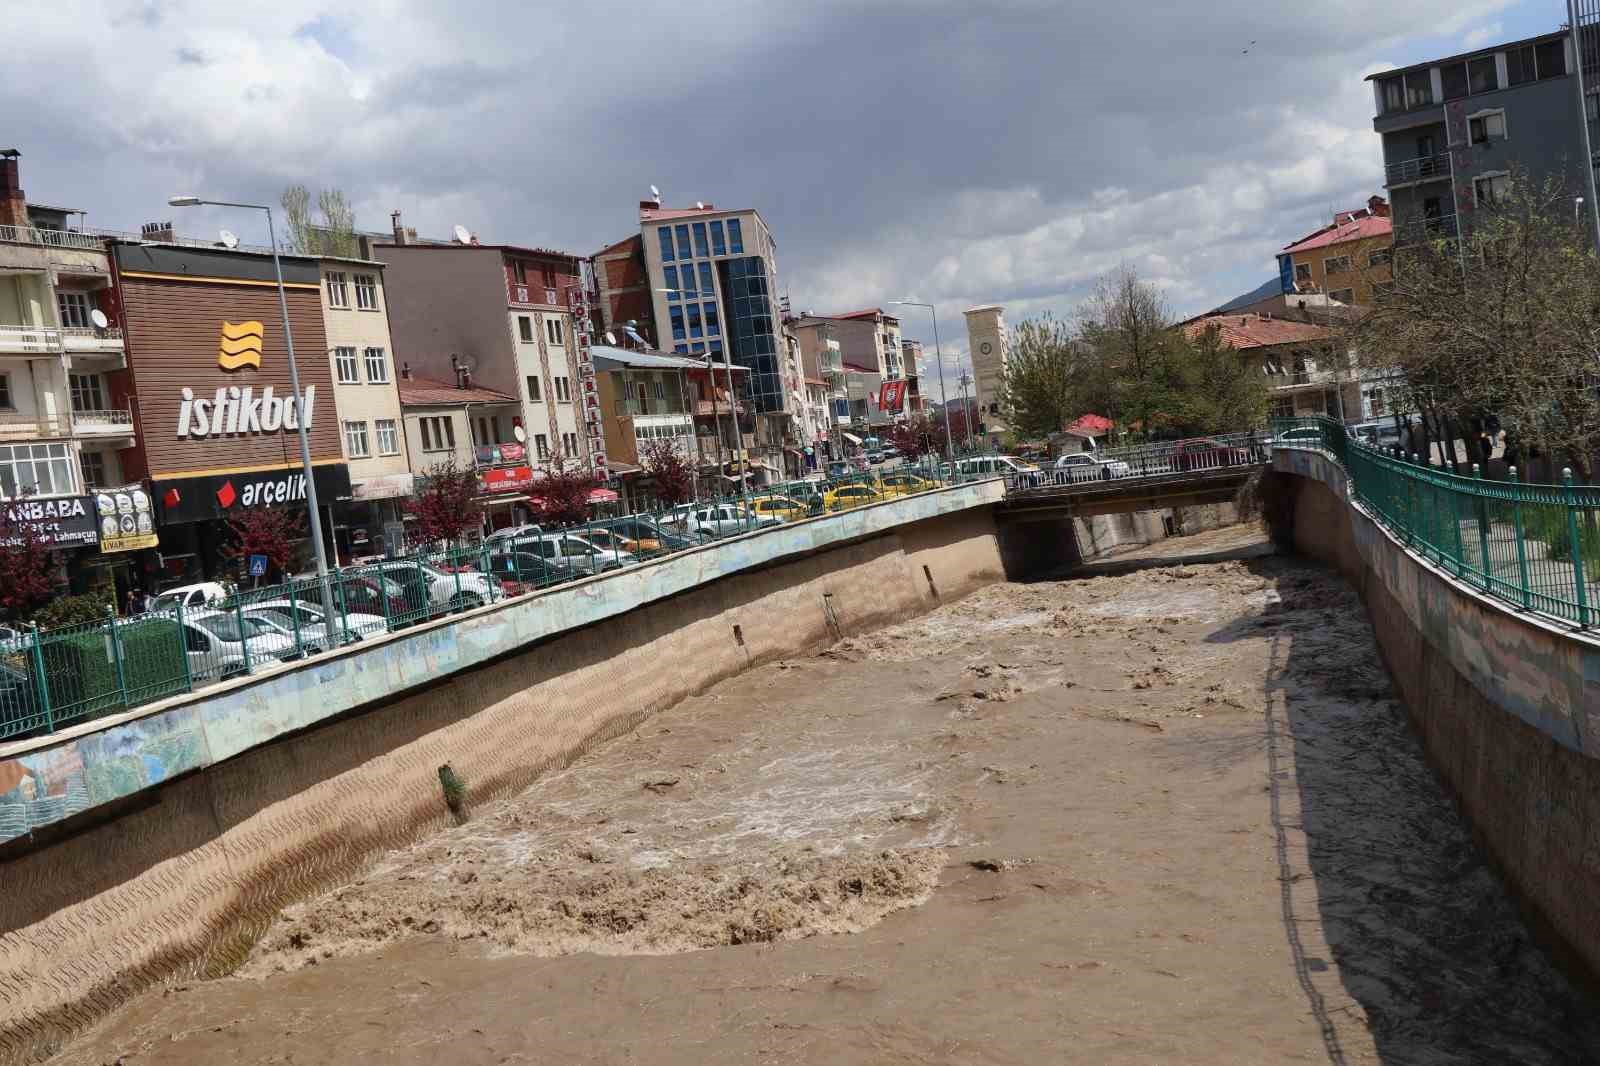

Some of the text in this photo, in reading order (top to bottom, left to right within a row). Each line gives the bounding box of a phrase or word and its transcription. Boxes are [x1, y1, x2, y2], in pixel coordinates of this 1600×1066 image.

[573, 290, 589, 361] HOTEL
[177, 385, 315, 437] istikbal
[241, 474, 307, 508] arçelik
[54, 530, 97, 542] Lahmacun
